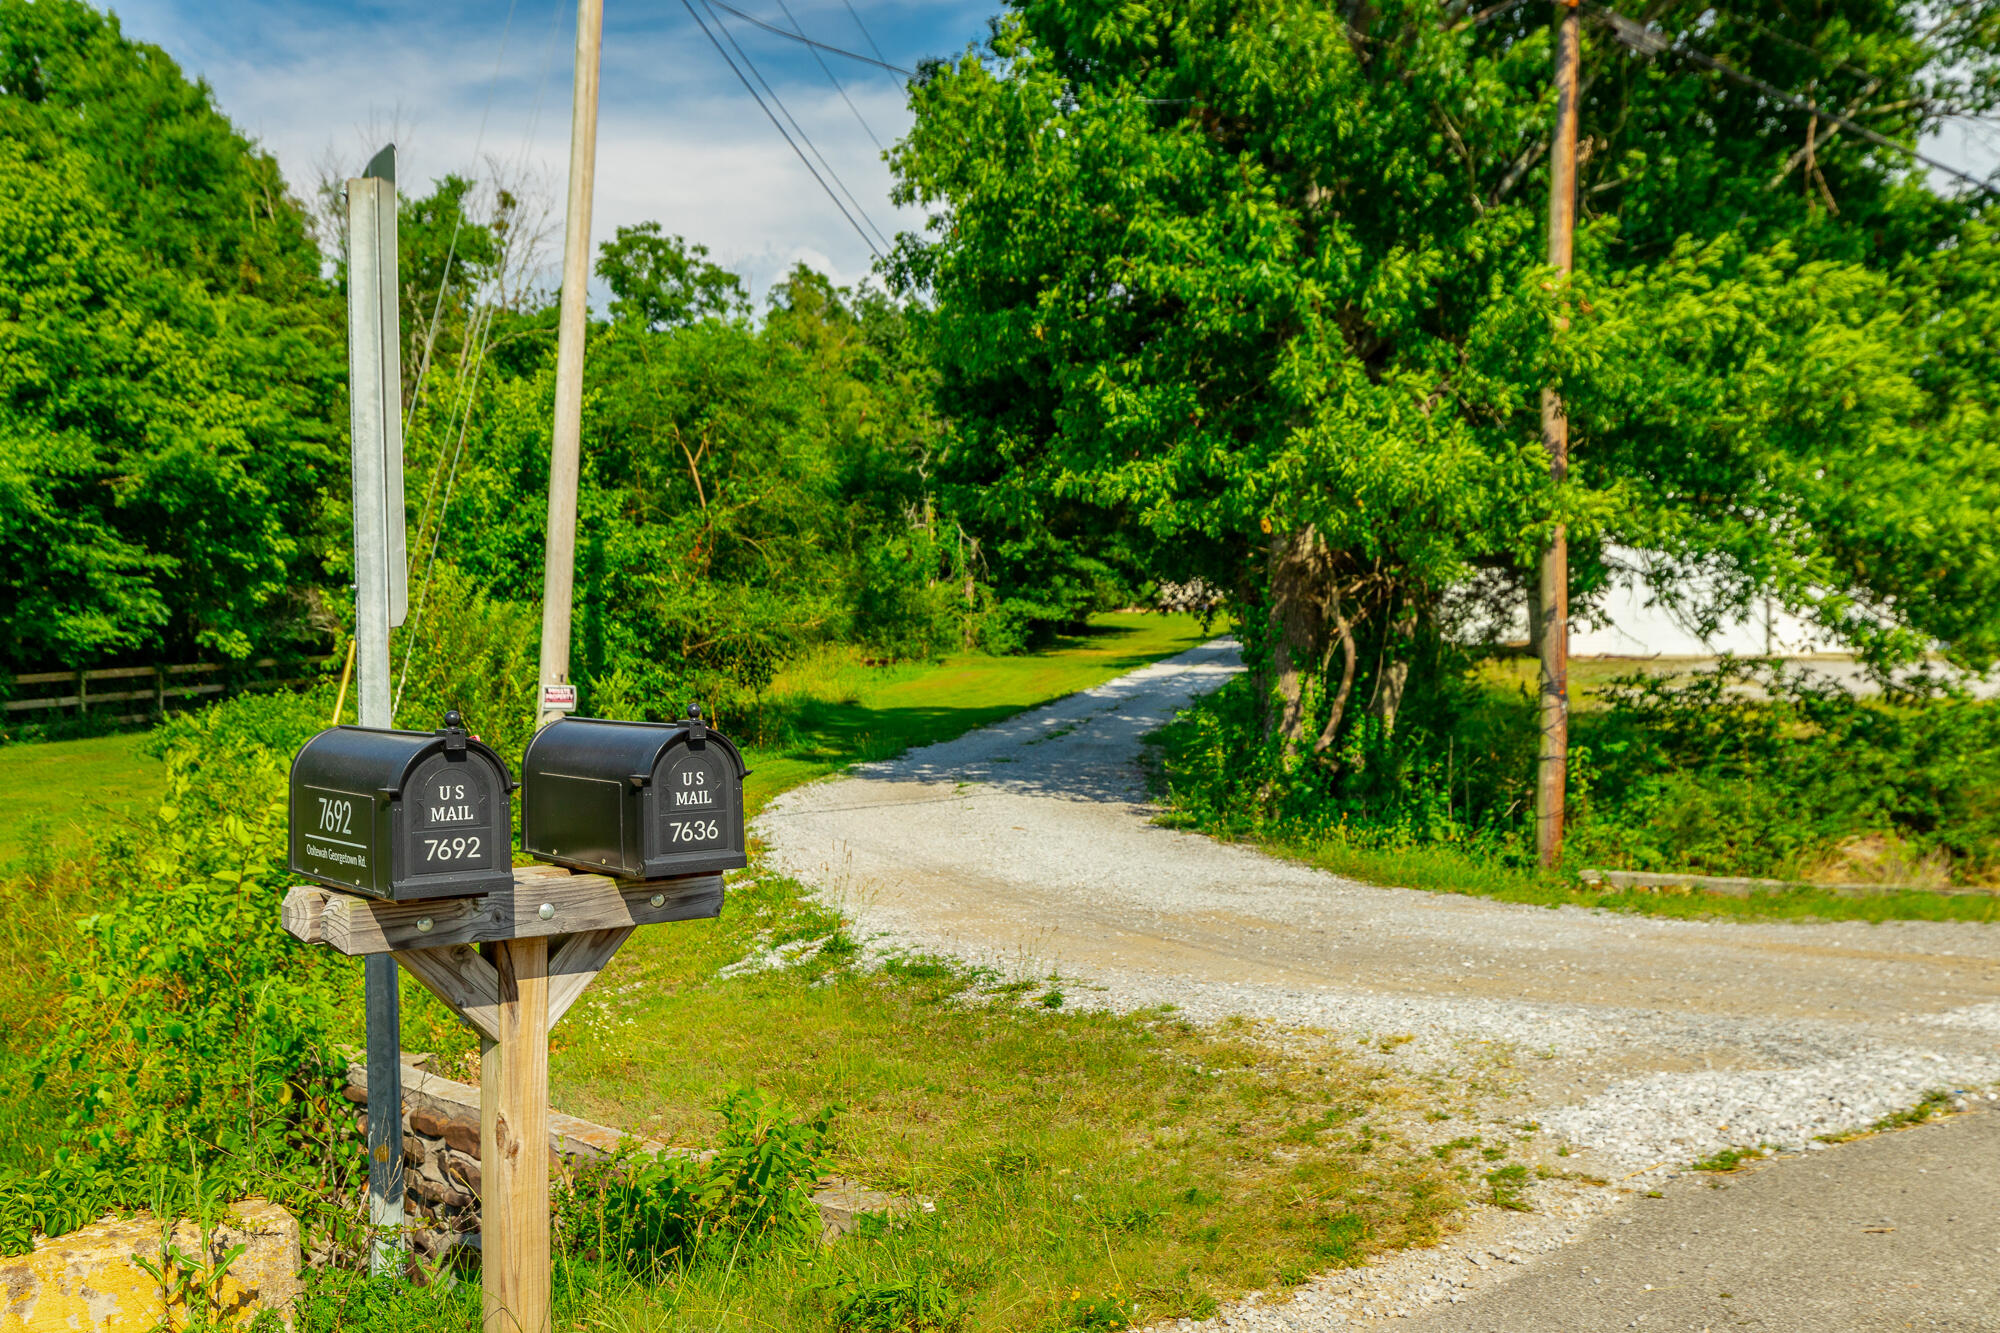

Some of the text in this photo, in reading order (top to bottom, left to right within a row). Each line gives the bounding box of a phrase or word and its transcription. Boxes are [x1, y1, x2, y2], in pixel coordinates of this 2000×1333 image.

[682, 771, 704, 786] U S
[439, 785, 464, 800] U S
[675, 790, 712, 806] MAIL
[318, 797, 352, 835] 7692
[430, 805, 474, 822] MAIL
[669, 819, 719, 842] 7636
[306, 843, 367, 868] Ooltewah Georgetown Rd.
[424, 836, 481, 861] 7692
